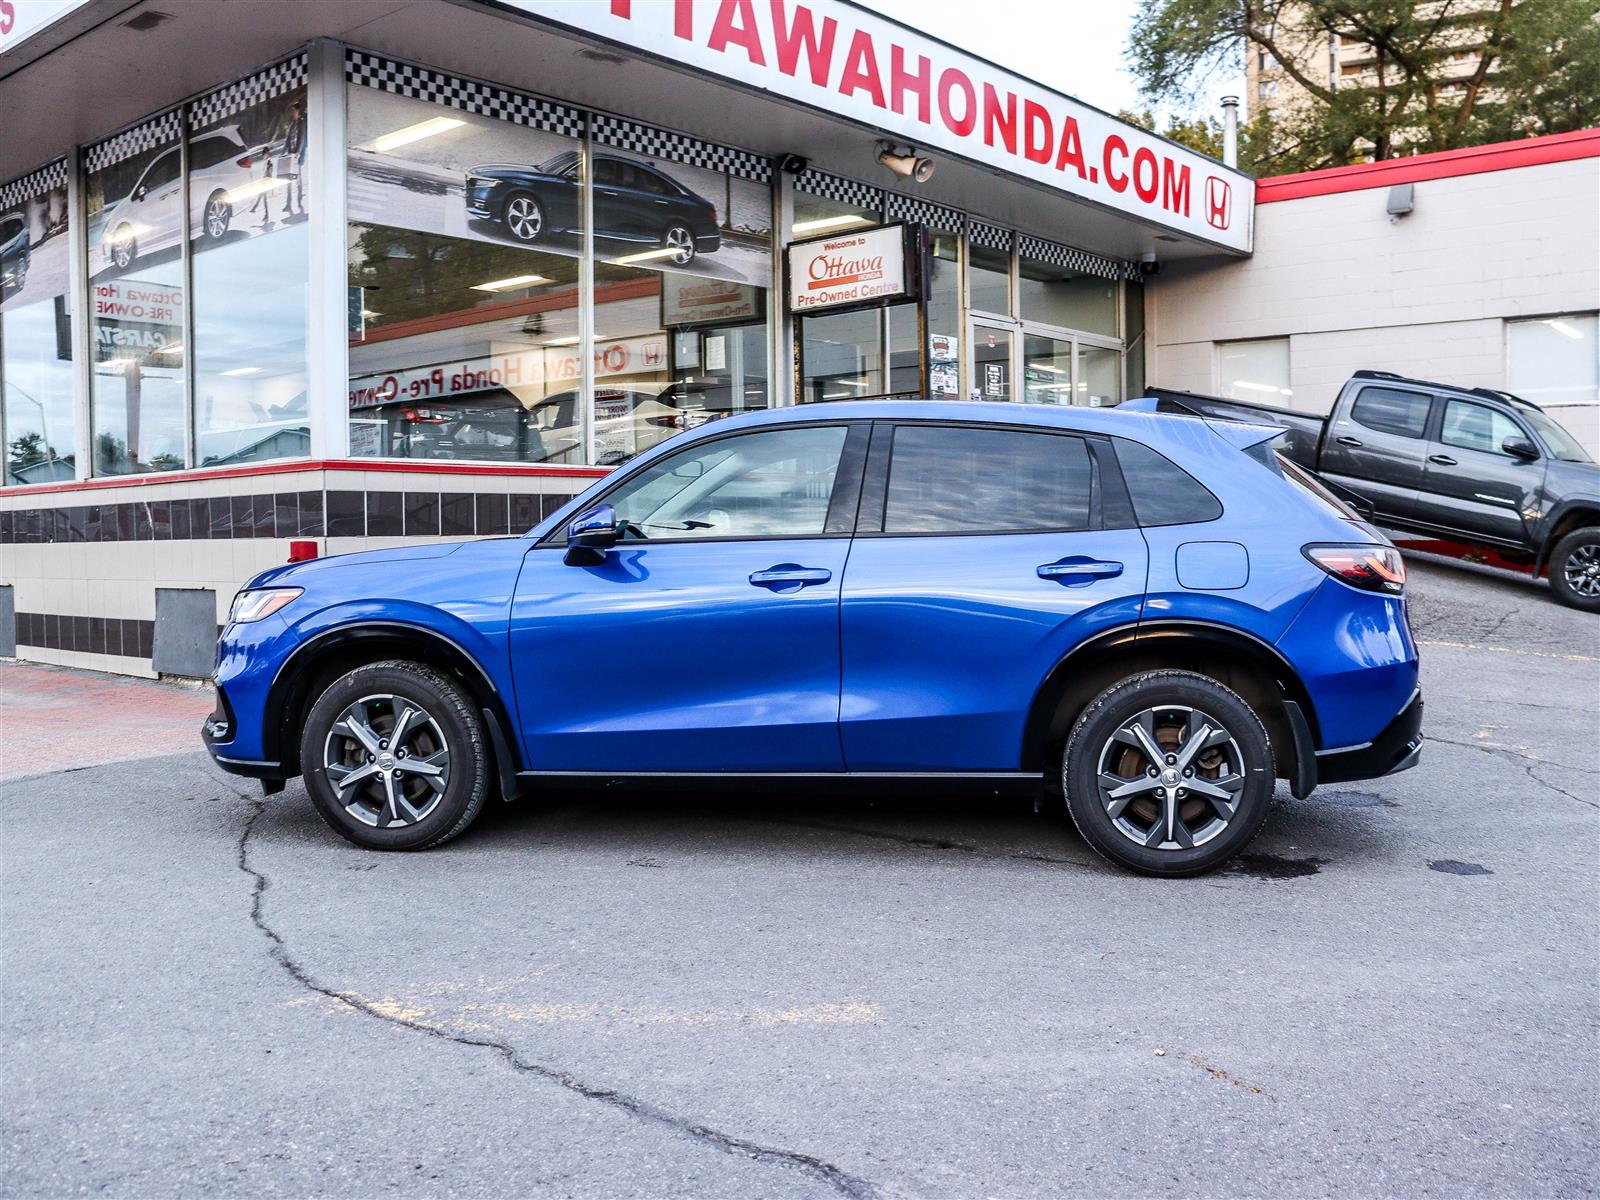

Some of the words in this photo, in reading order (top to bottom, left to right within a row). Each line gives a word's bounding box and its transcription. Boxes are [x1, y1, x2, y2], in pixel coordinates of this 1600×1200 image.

[610, 0, 1191, 218] AWAHONDA.COM
[824, 239, 856, 252] Welcome
[808, 254, 883, 280] Ottawa
[798, 287, 857, 306] Pre-Owned
[861, 281, 899, 297] Centre
